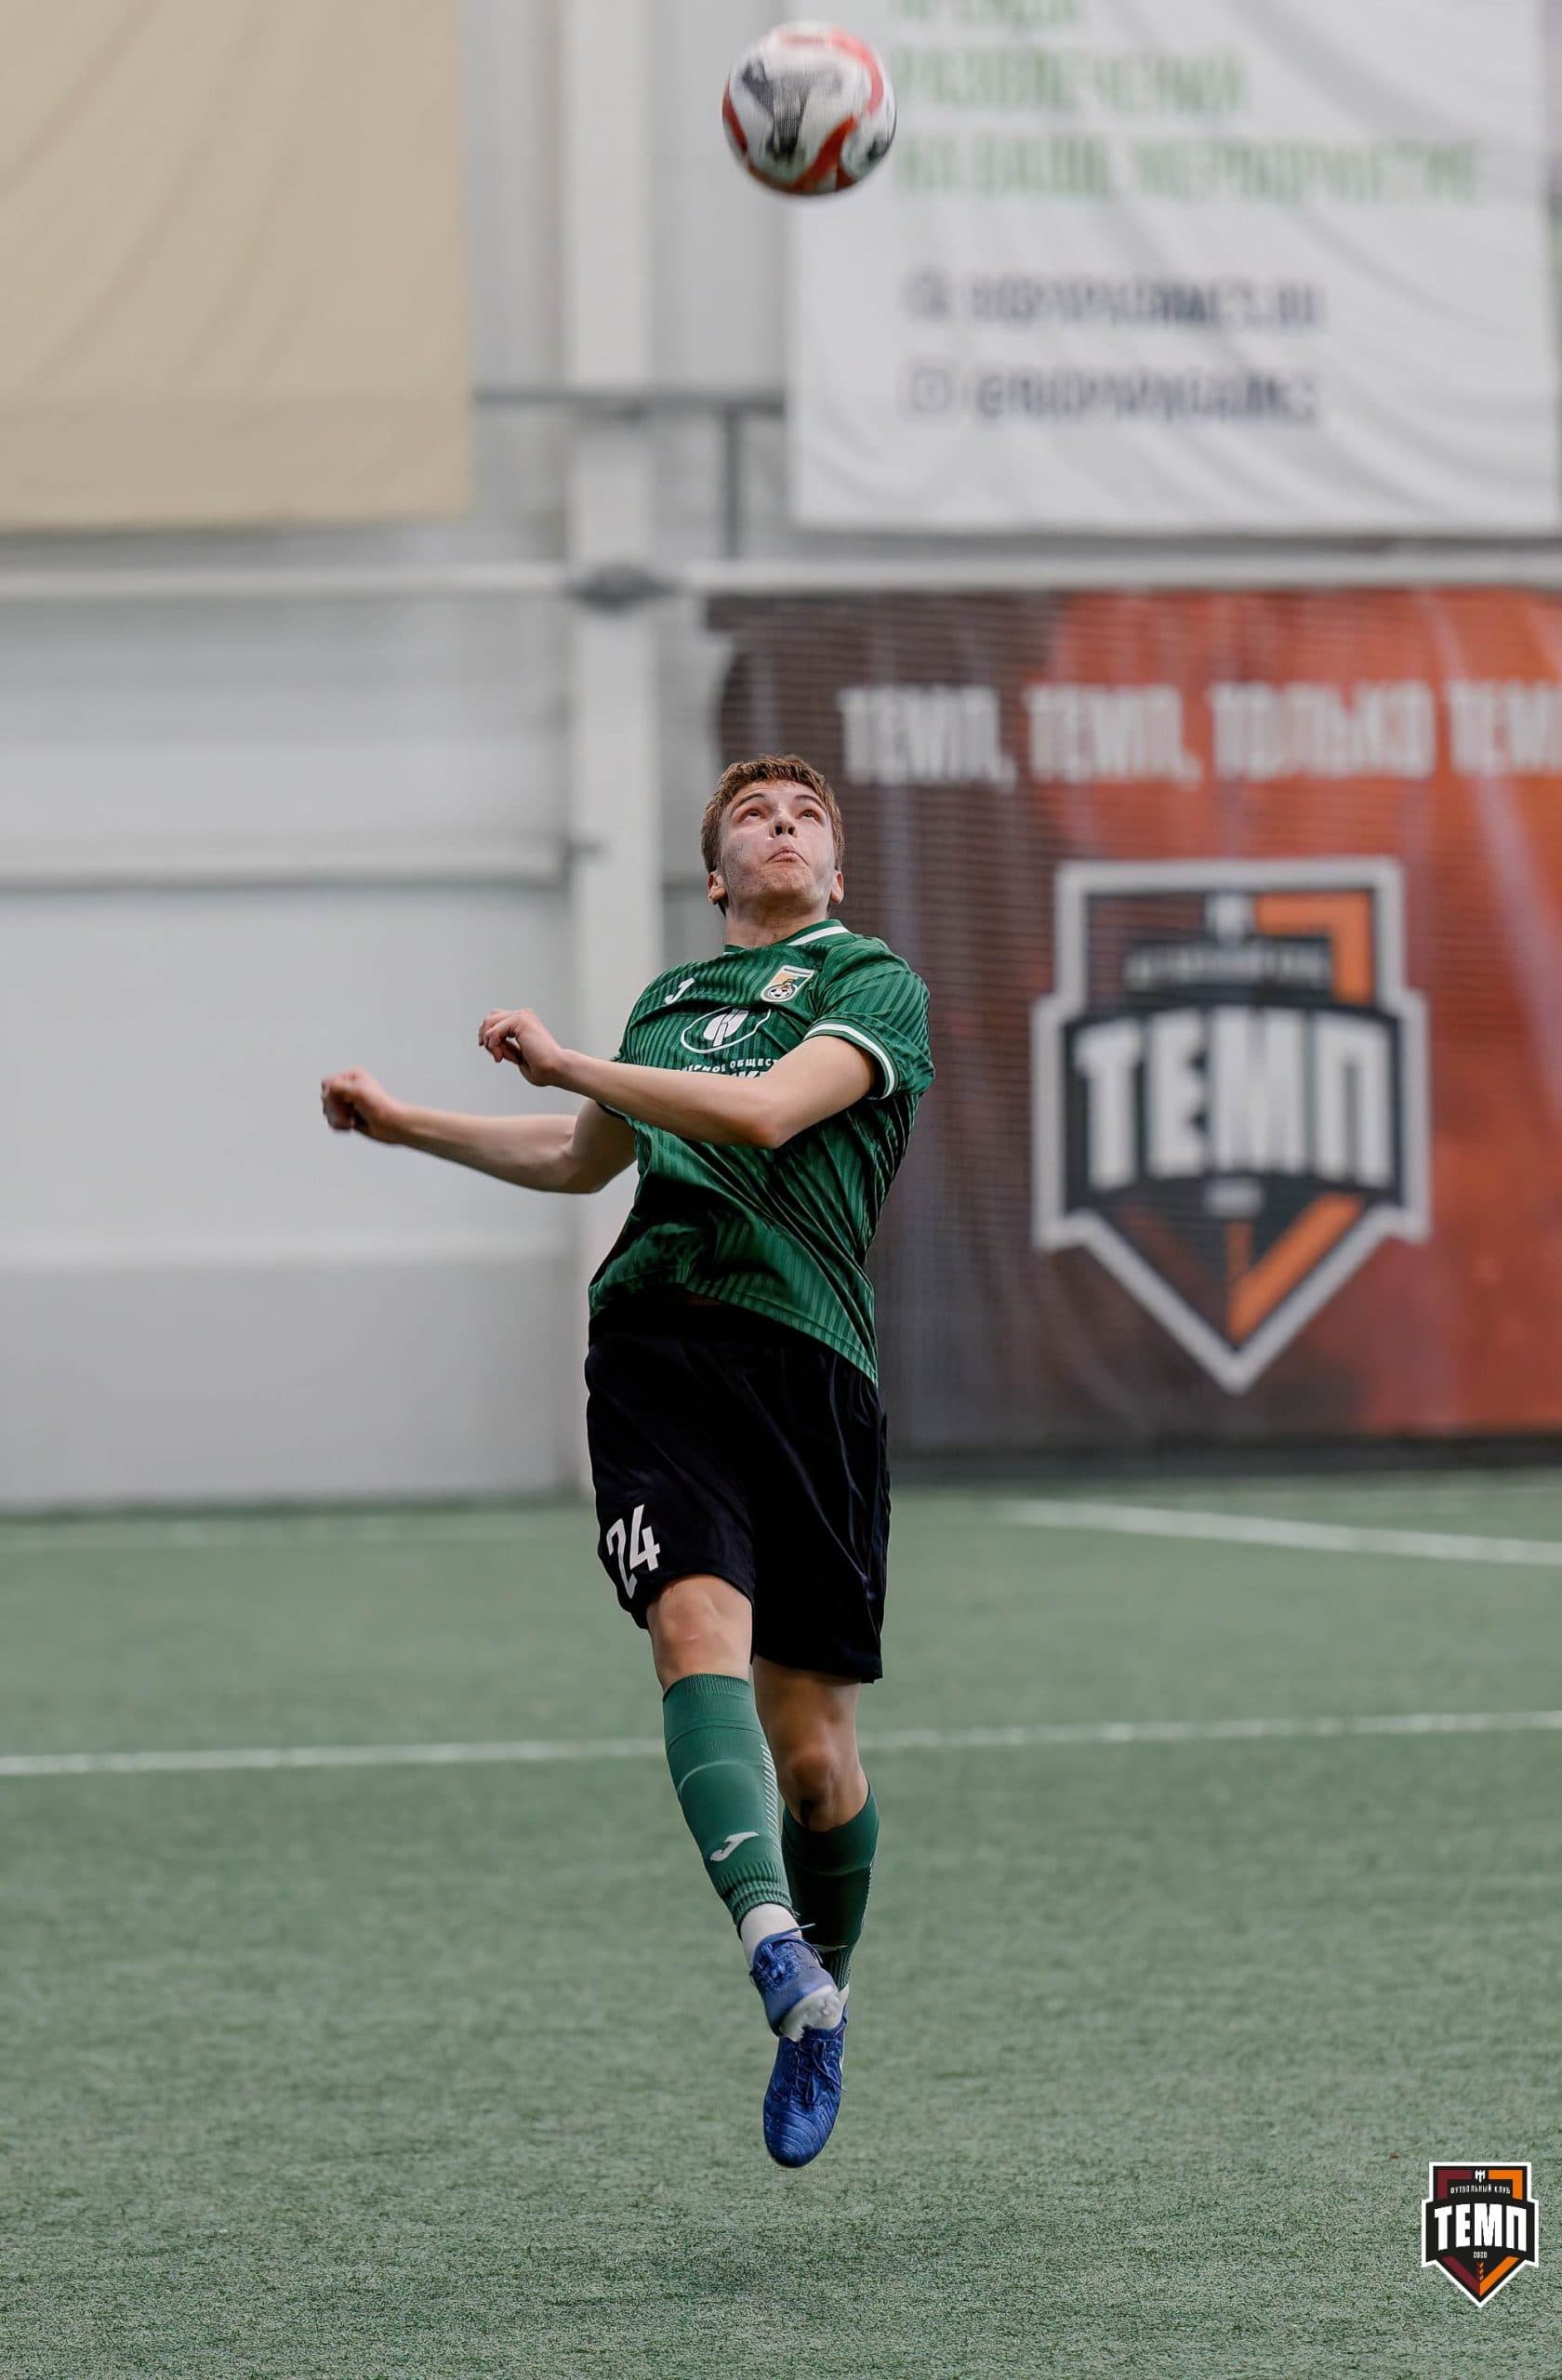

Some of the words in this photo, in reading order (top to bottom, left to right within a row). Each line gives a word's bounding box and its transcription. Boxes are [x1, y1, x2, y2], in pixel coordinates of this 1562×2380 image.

[841, 685, 1013, 790] ТЕМП,
[1027, 683, 1200, 787] ТЕМП,
[1213, 680, 1435, 781] ТОЛЬКО
[1073, 1004, 1395, 1194] ТЕМП
[605, 1503, 661, 1599] 24
